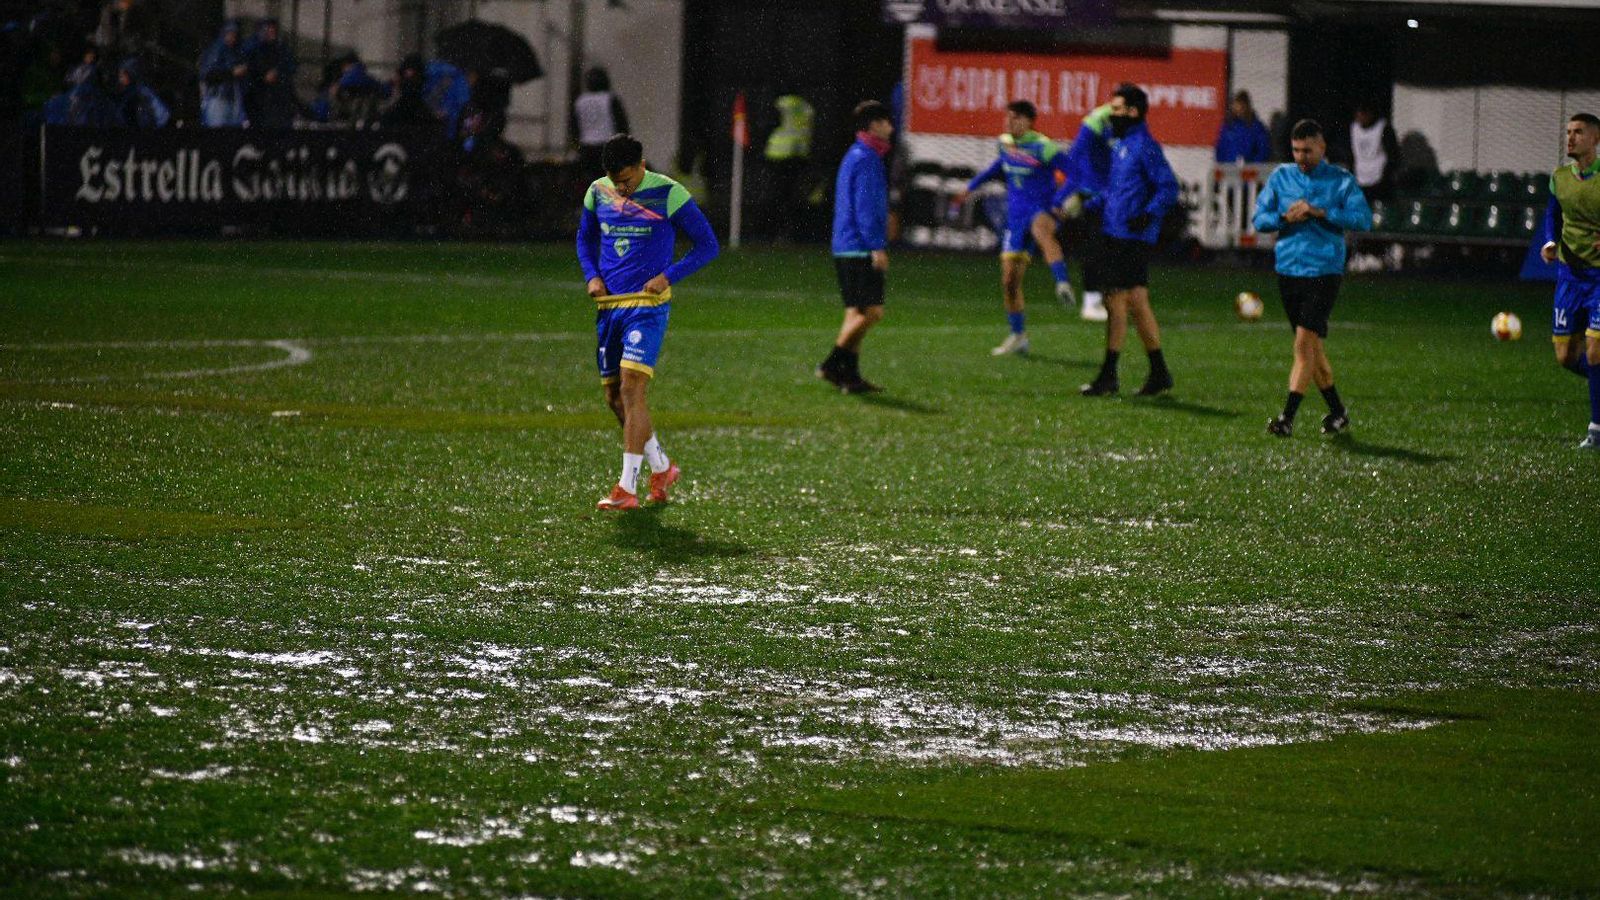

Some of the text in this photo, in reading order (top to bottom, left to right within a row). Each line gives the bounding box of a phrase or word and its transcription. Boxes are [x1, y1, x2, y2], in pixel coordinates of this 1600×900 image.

[950, 66, 1100, 115] COPA DEL REY
[76, 146, 223, 202] Estrella
[1555, 308, 1567, 328] 14
